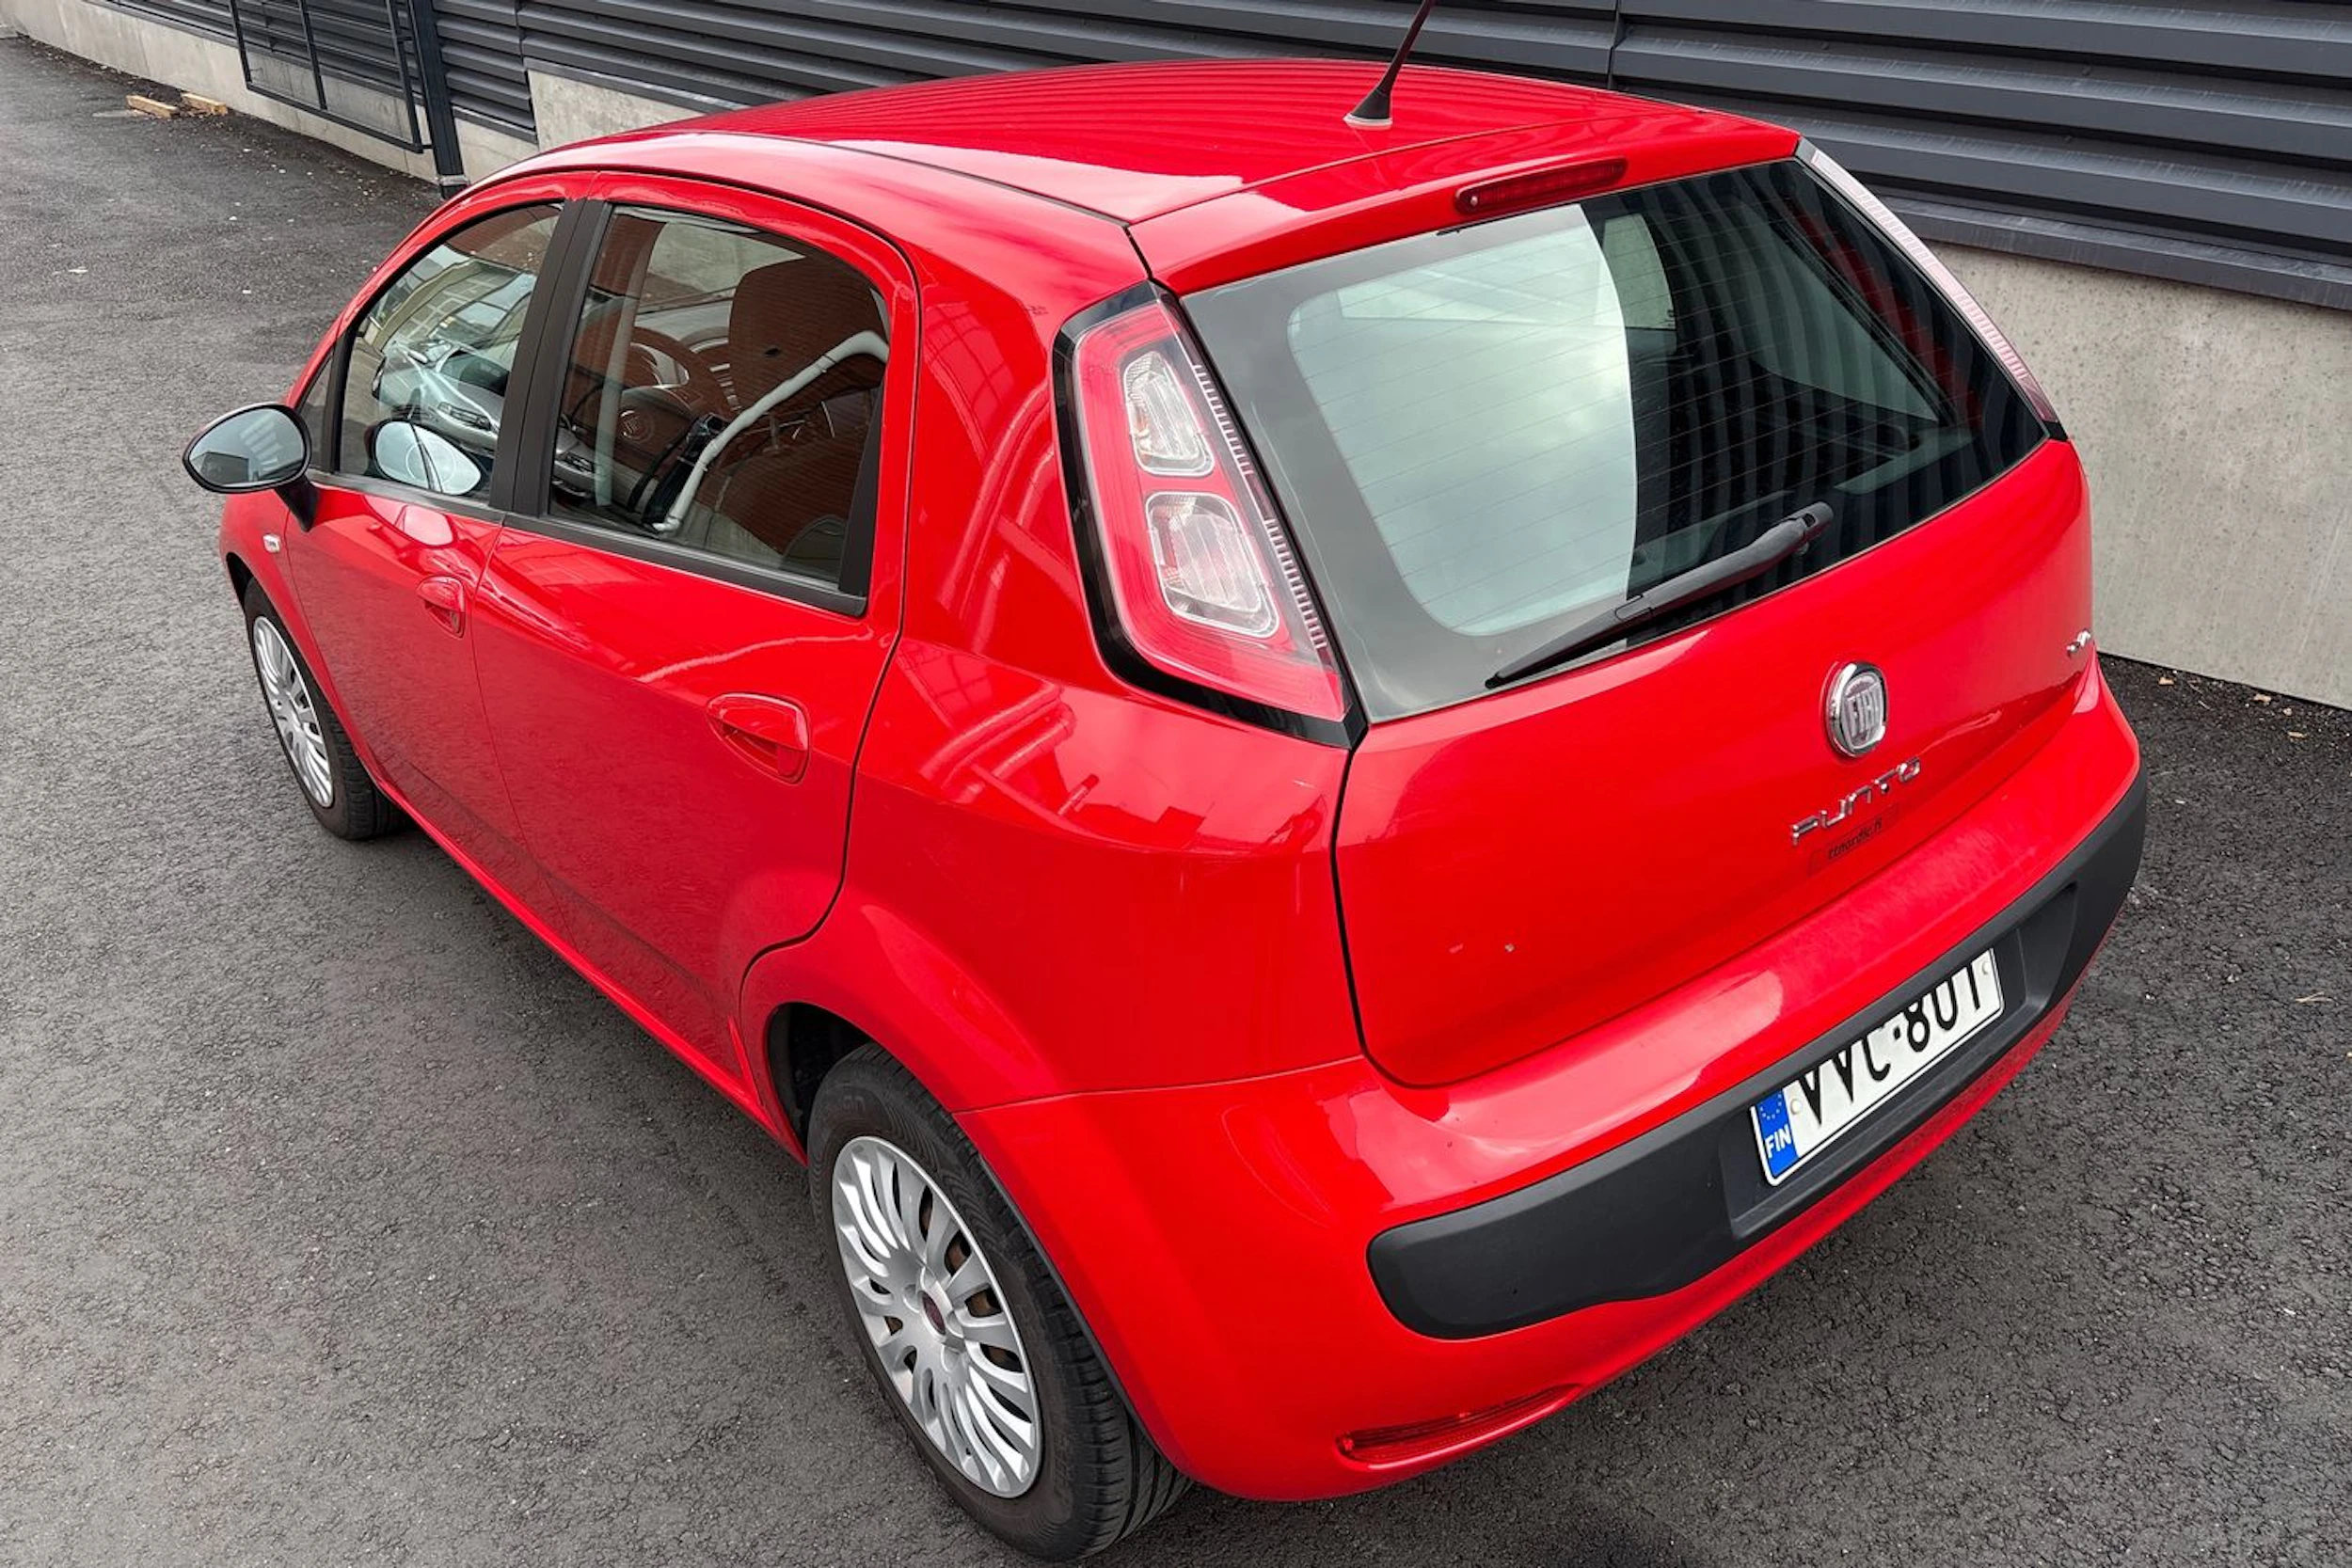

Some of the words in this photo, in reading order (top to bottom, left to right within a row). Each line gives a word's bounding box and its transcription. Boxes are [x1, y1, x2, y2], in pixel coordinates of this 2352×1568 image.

[1846, 682, 1883, 738] FIAT
[1791, 756, 1920, 846] PUNTO
[1765, 1125, 1792, 1159] FIN
